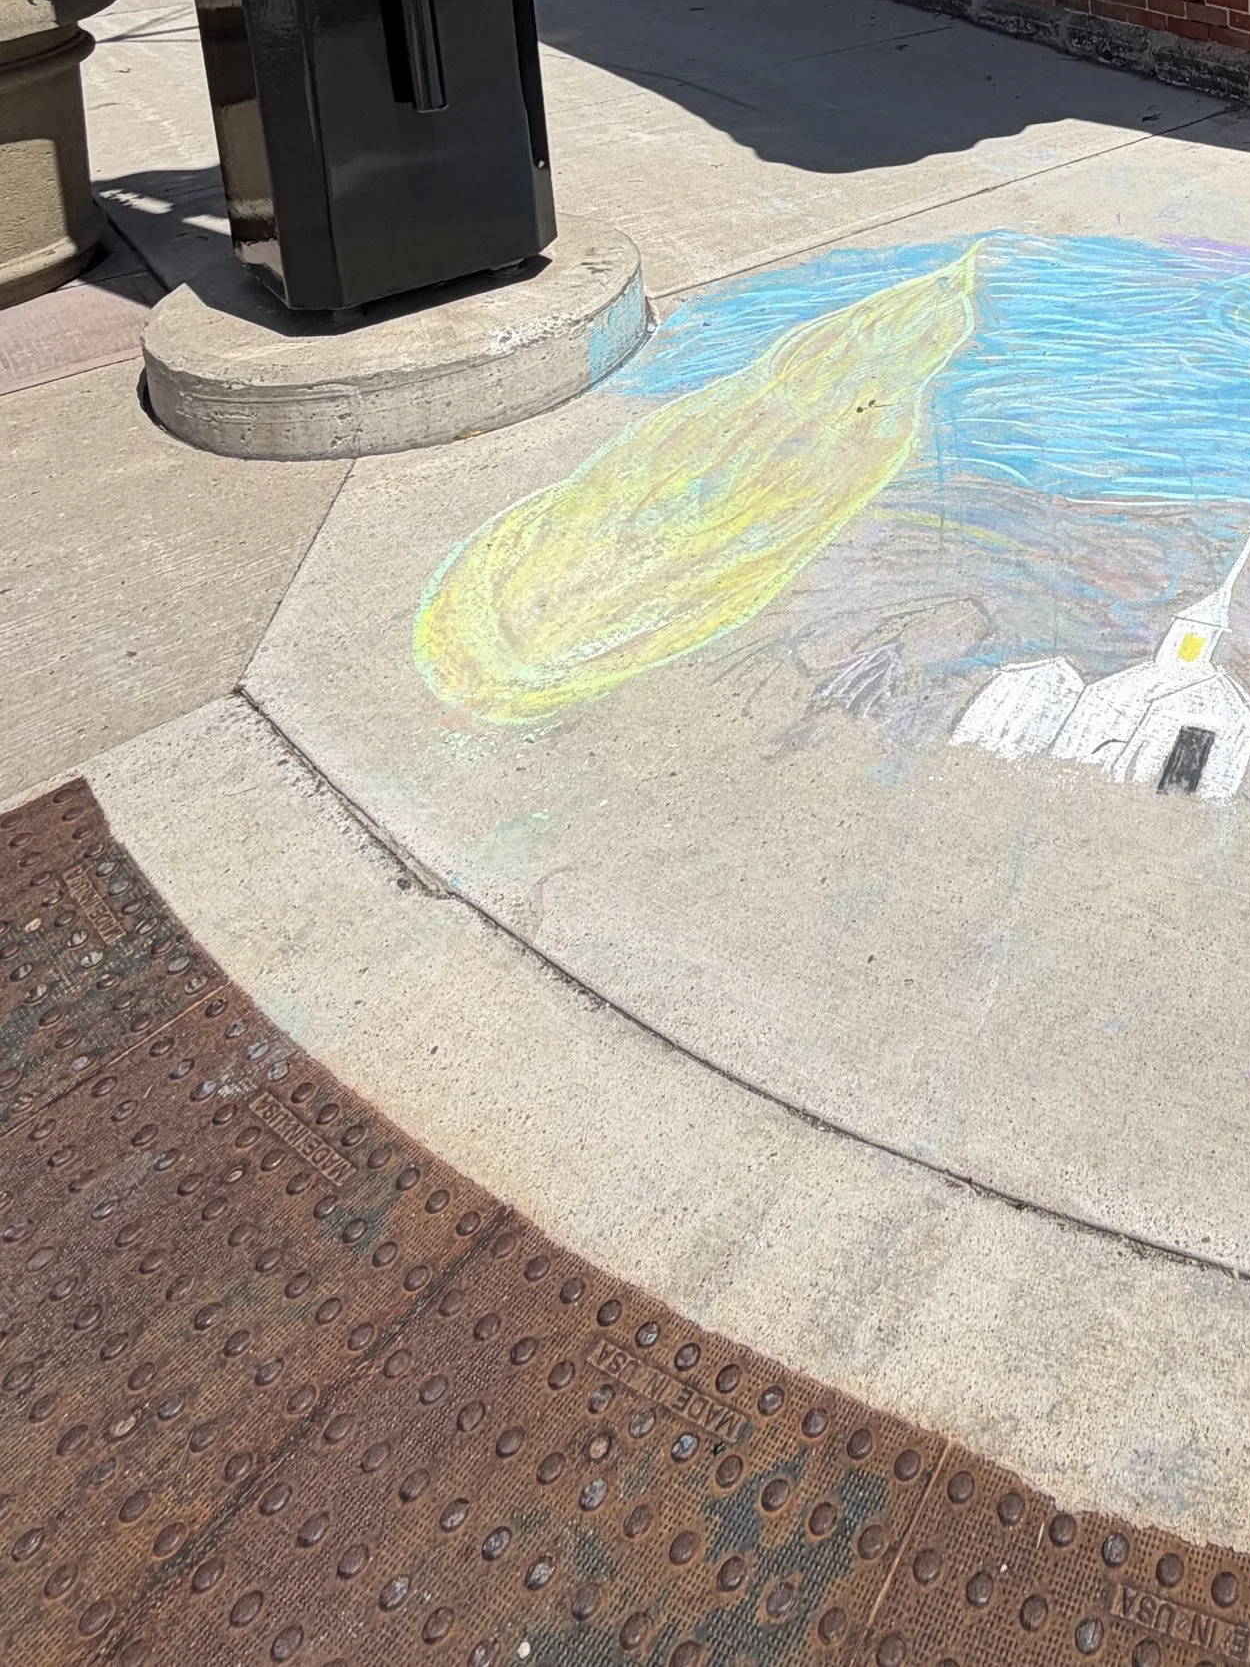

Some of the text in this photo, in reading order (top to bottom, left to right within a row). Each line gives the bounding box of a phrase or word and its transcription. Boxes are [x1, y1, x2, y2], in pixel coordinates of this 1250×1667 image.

[594, 1341, 745, 1443] MADE IN USA
[1117, 1588, 1176, 1635] USA
[1188, 1613, 1220, 1650] IN
